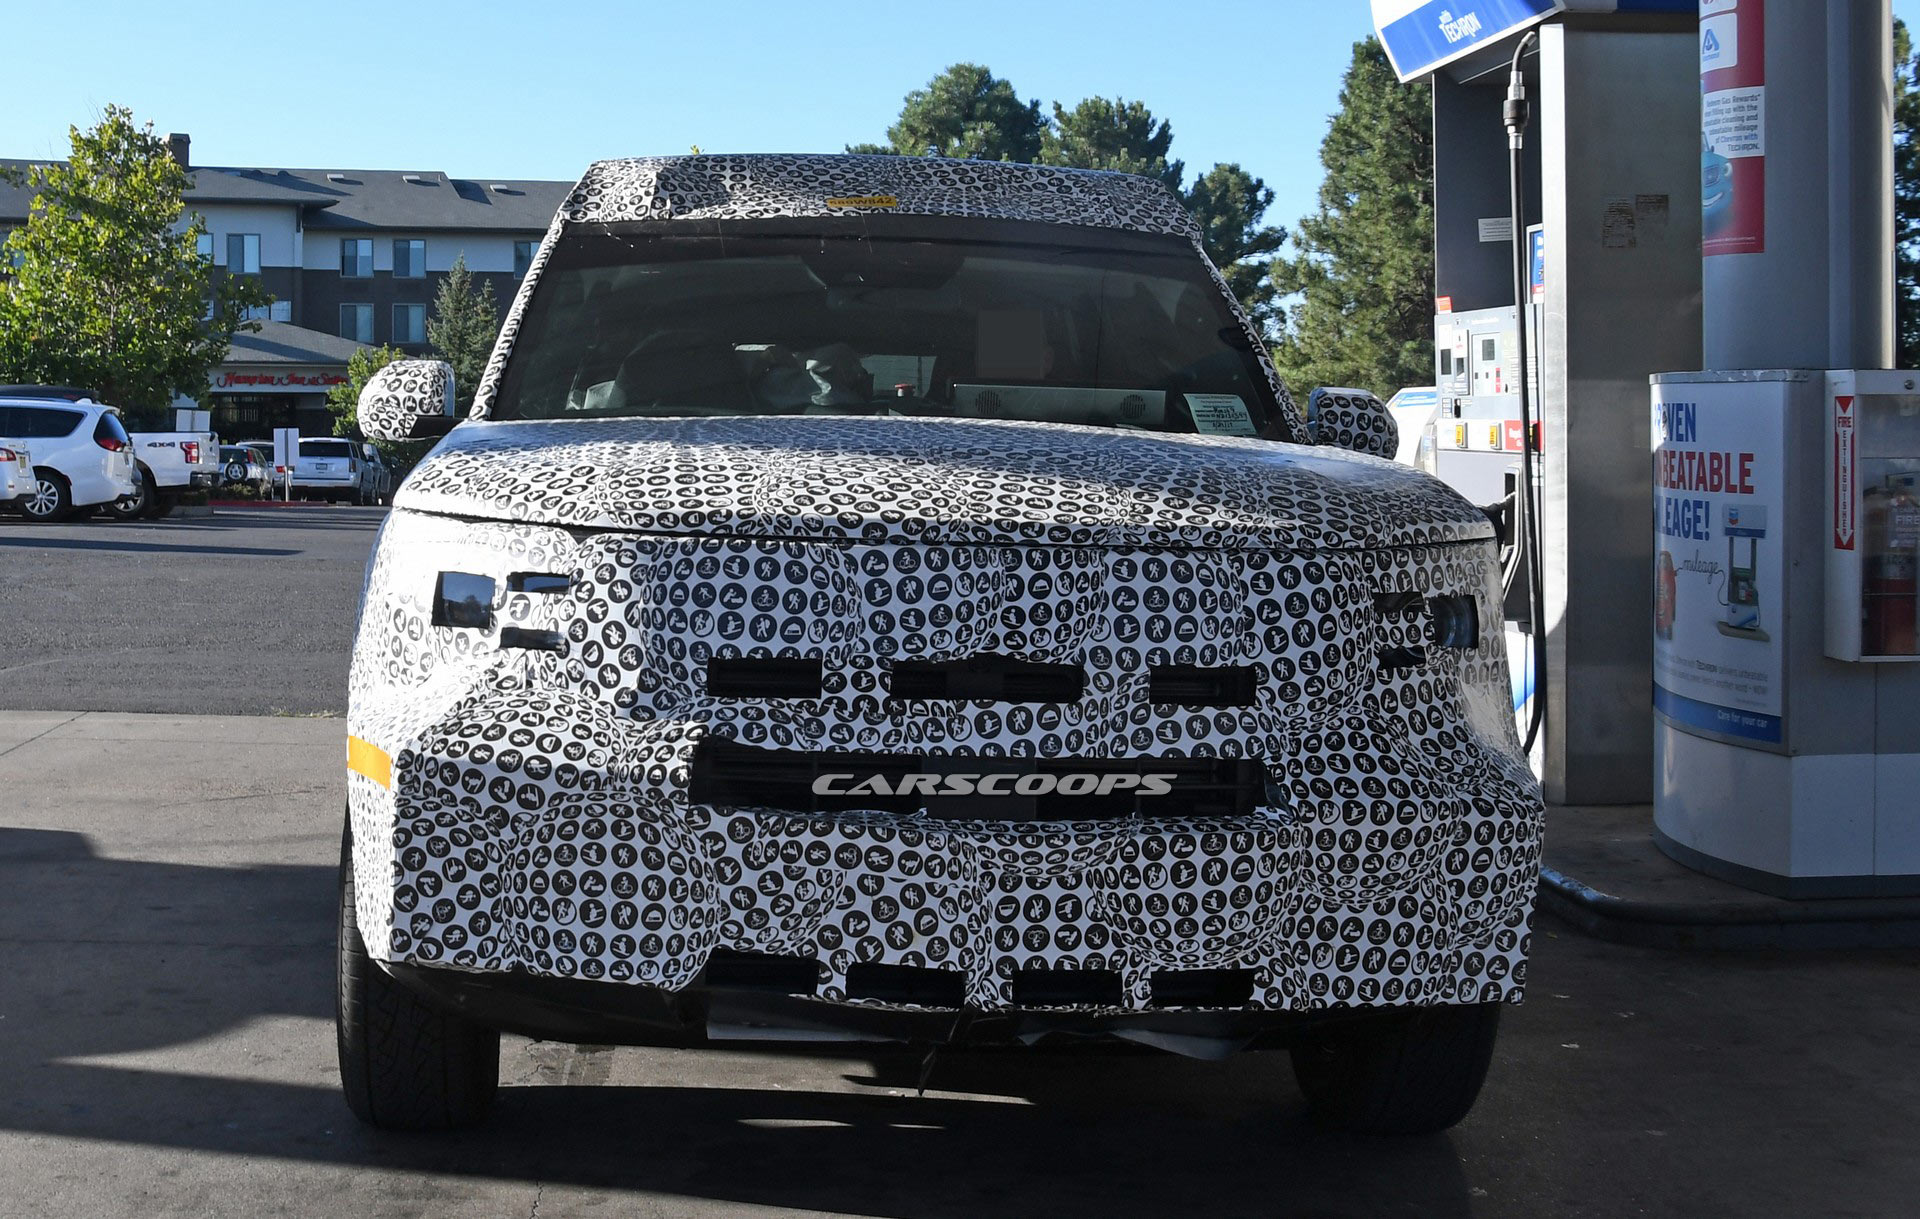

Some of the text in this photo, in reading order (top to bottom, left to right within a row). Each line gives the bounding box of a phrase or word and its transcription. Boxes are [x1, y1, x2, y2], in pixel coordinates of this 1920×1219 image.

[1438, 11, 1482, 44] TECHRON
[1722, 115, 1745, 123] cleaning
[1746, 112, 1758, 121] and
[1733, 124, 1758, 132] mileage
[1721, 135, 1742, 143] Chevron
[217, 372, 279, 387] Hampton
[1837, 416, 1852, 428] FIRE
[1683, 549, 1719, 585] mileage
[1718, 709, 1768, 728] Care for your car
